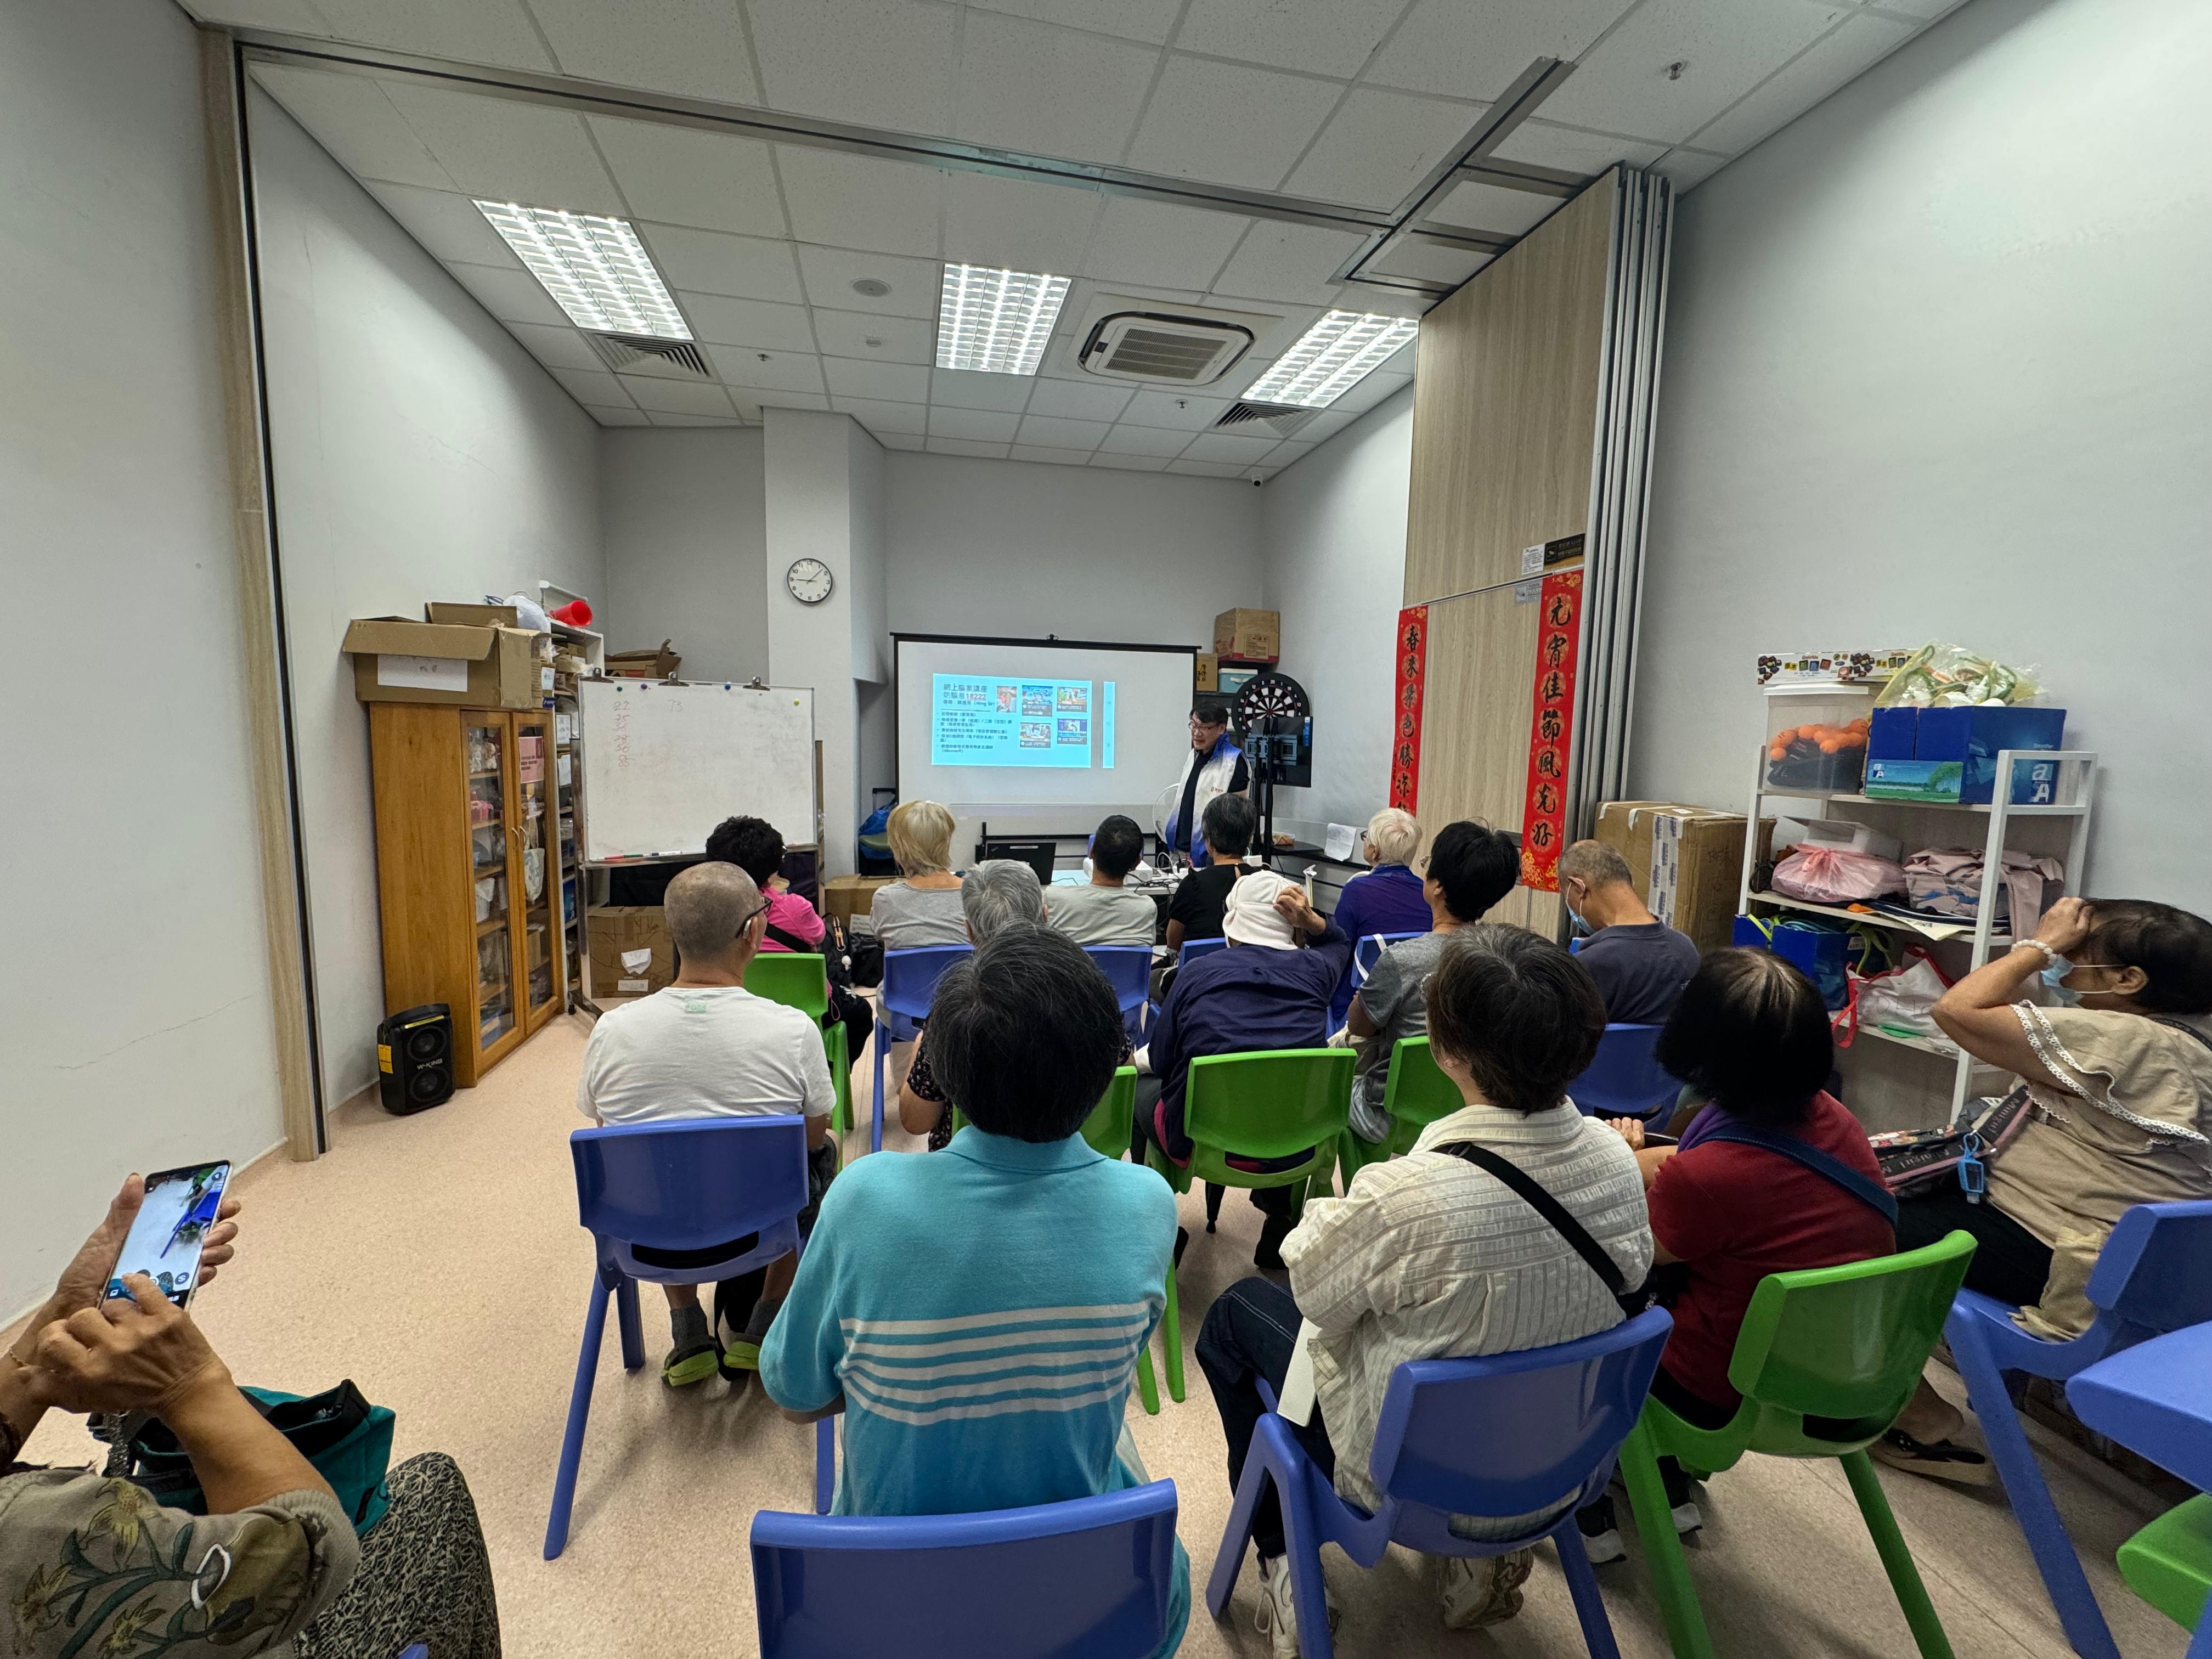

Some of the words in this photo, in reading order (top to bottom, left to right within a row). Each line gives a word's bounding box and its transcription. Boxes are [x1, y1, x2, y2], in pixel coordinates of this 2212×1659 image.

[1532, 597, 1572, 847] 元宵佳節風光好
[417, 1058, 443, 1070] W-KING
